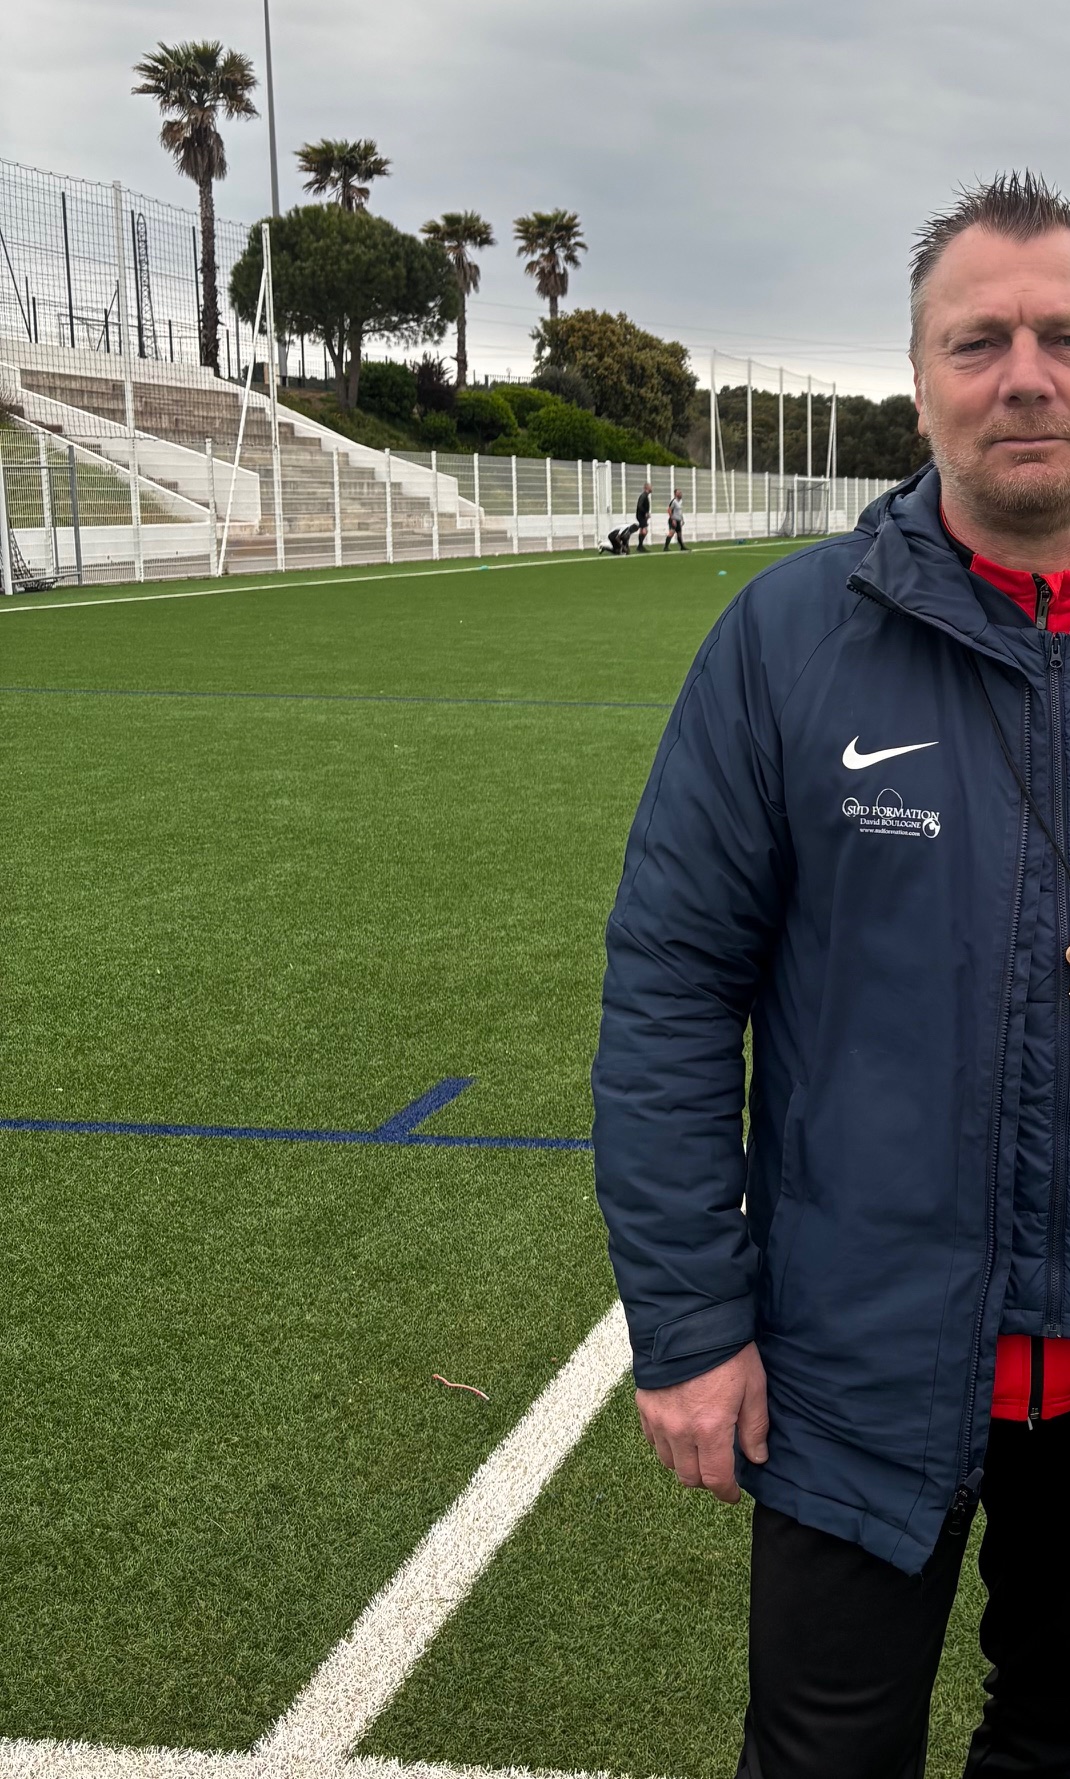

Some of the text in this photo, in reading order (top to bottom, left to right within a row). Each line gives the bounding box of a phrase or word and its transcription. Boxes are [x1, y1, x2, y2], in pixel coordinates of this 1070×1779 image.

[847, 805, 940, 821] SUD FORMATION
[860, 818, 922, 829] David BOULOGNE
